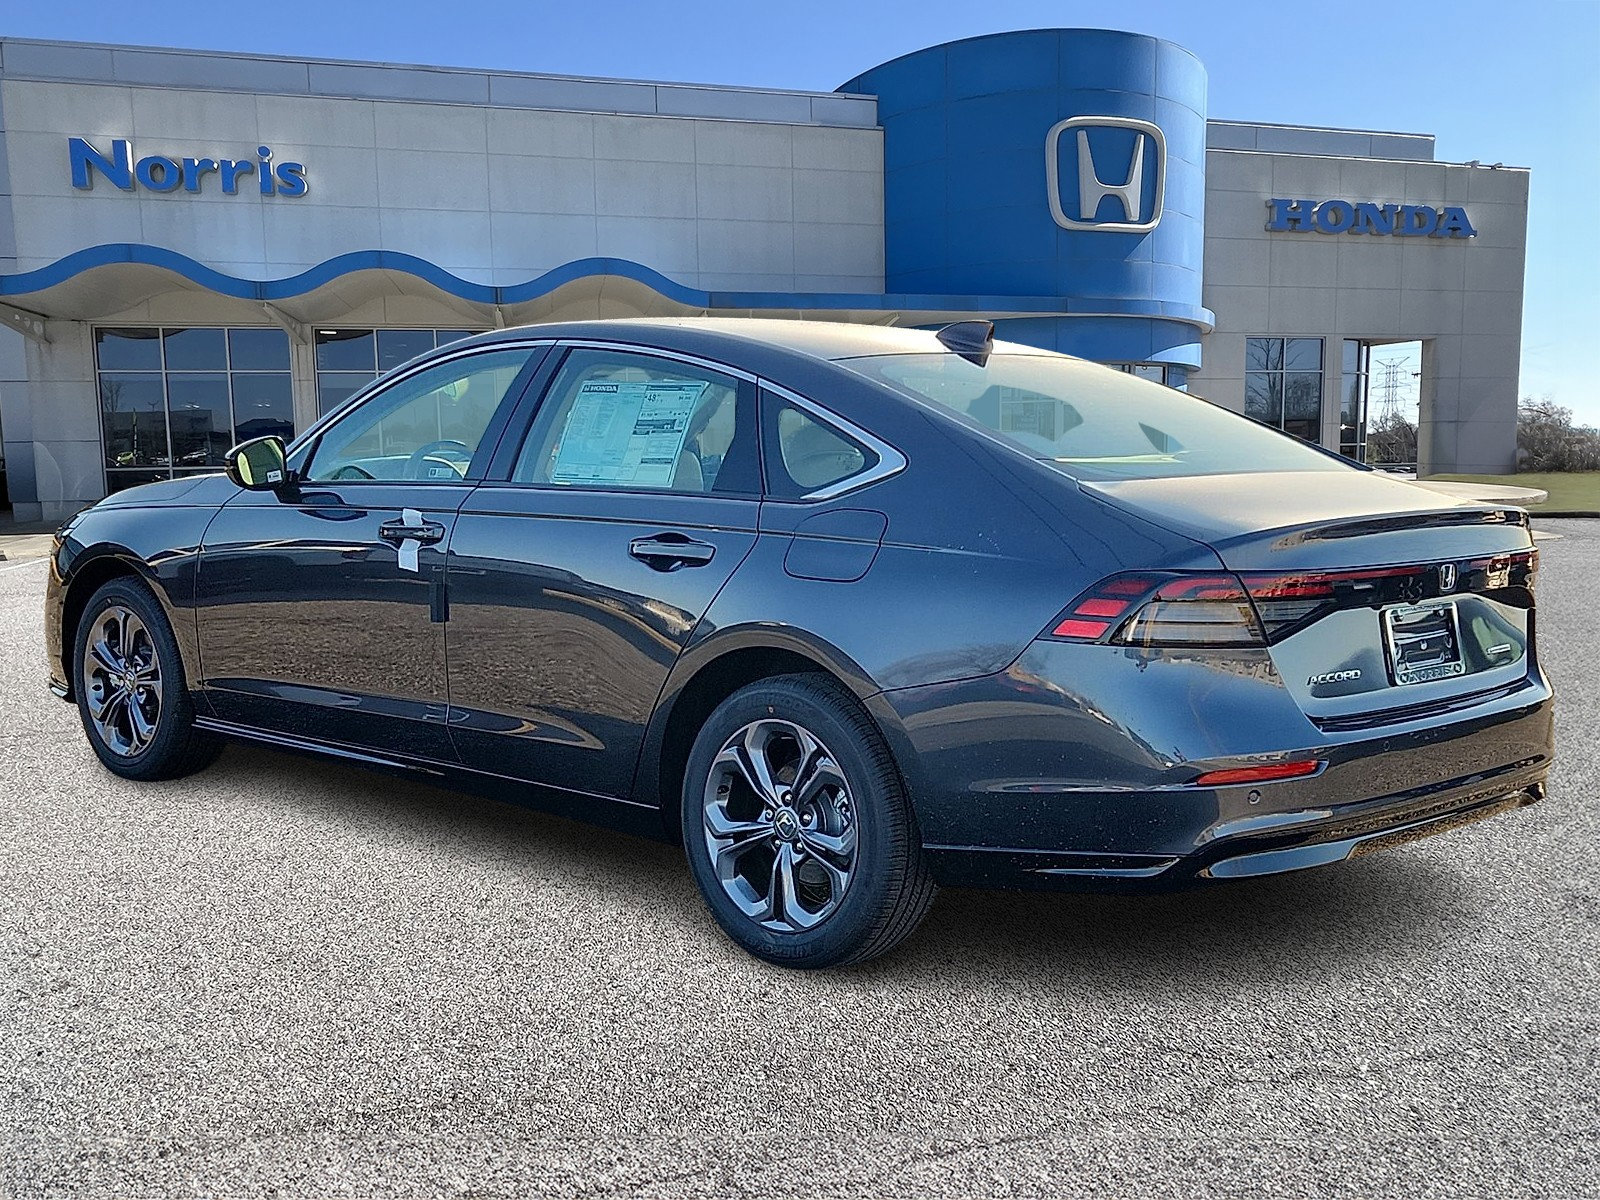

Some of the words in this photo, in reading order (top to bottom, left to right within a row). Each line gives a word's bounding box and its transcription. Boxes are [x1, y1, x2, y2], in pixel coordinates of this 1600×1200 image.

[68, 137, 308, 197] Norris
[1265, 198, 1477, 238] HONDA
[1306, 668, 1361, 685] ACCORD
